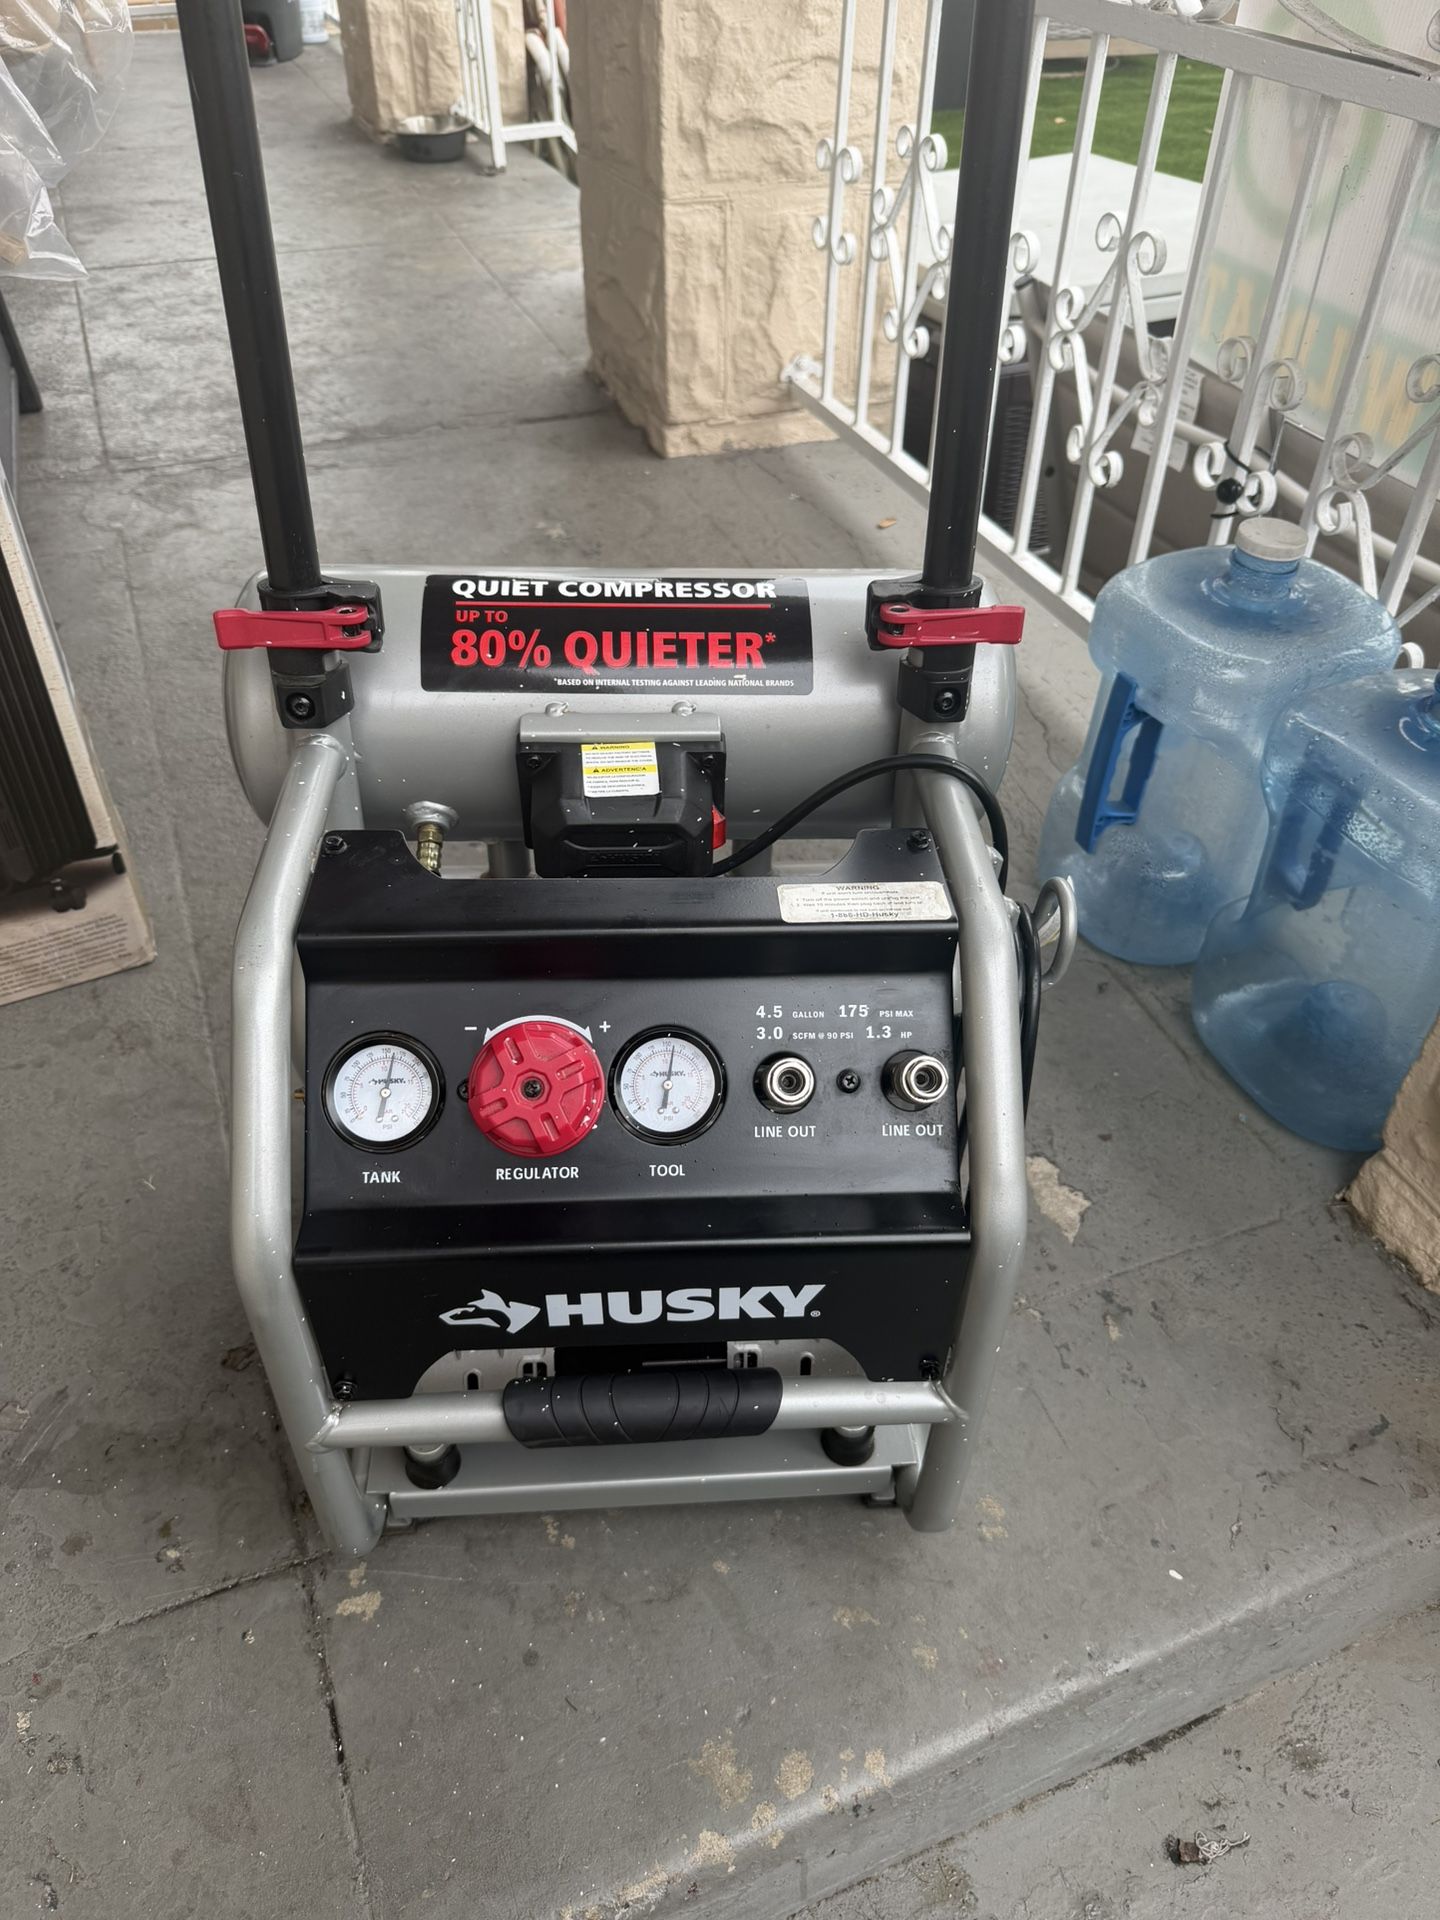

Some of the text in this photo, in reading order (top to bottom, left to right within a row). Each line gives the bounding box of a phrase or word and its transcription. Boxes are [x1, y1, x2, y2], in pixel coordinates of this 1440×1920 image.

[452, 579, 777, 598] QUIET COMPRESSOR
[456, 610, 509, 623] UP TO
[451, 628, 552, 668] 80%
[632, 679, 661, 687] TESTING
[662, 679, 693, 687] AGAINST
[695, 679, 727, 687] LEADING
[728, 679, 764, 687] NATIONAL
[755, 1005, 783, 1019] 4.5
[838, 1004, 869, 1018] 175
[879, 1010, 893, 1018] PSI
[895, 1010, 914, 1018] MAX
[756, 1026, 783, 1040] 3.0
[792, 1032, 816, 1040] SCFM
[827, 1032, 838, 1040] 90
[866, 1025, 892, 1039] 1.3
[900, 1031, 912, 1039] HP
[754, 1125, 816, 1138] LINE OUT
[882, 1124, 944, 1137] LINE OUT
[496, 1166, 579, 1180] REGULATOR
[649, 1164, 686, 1176] TOOL
[362, 1171, 401, 1184] TANK
